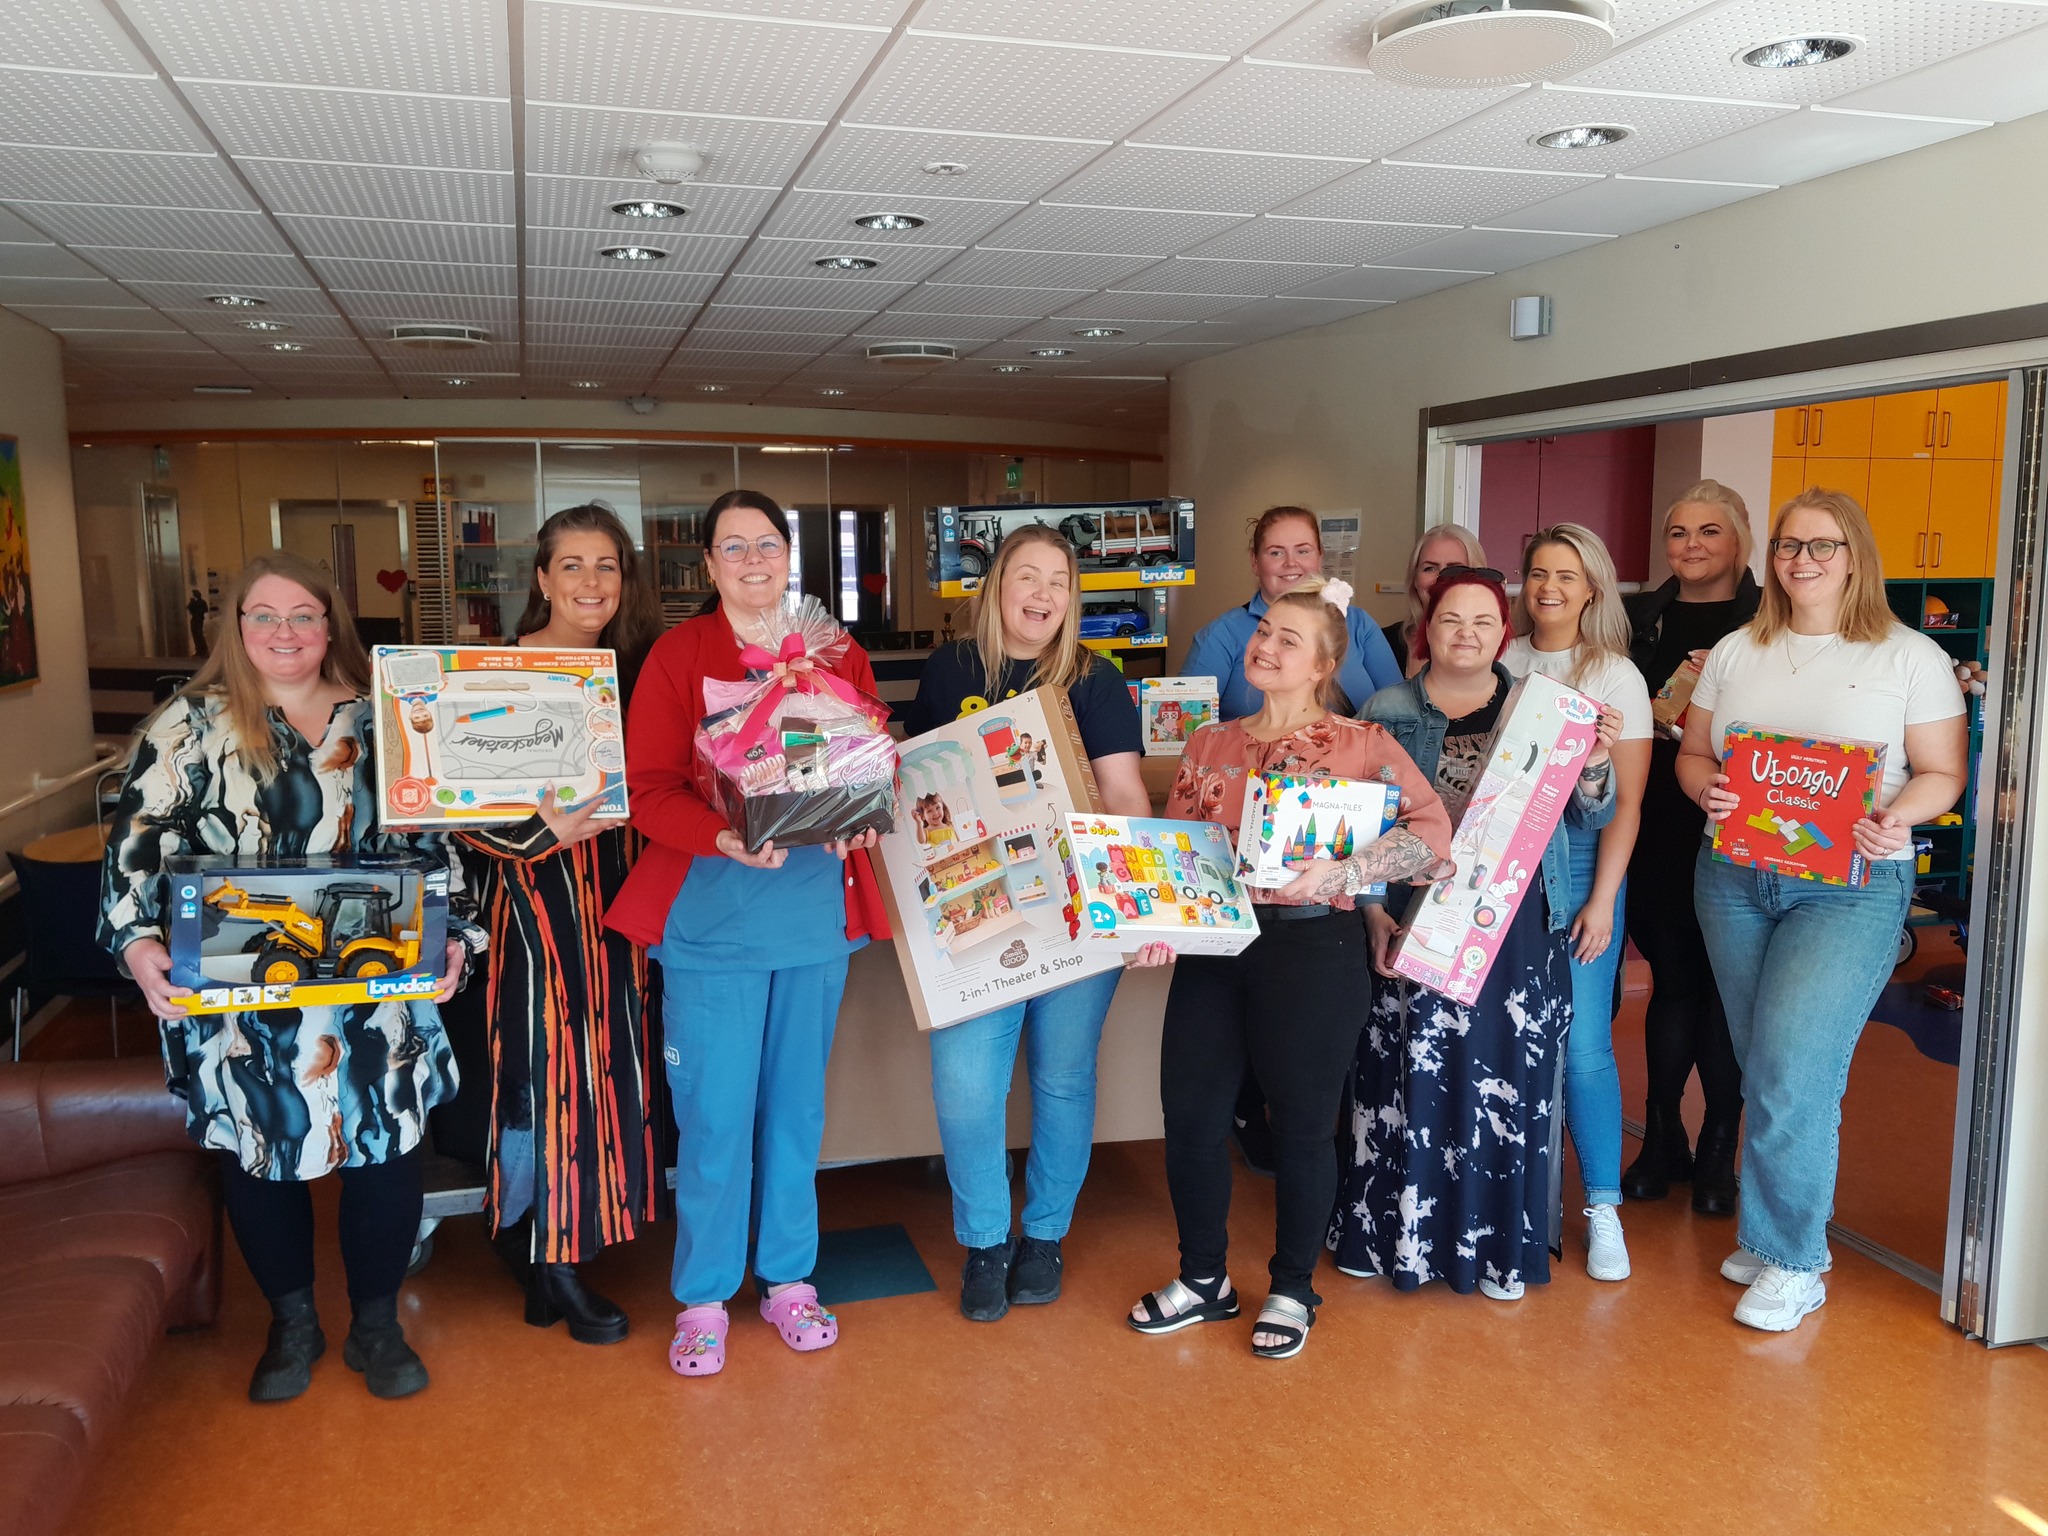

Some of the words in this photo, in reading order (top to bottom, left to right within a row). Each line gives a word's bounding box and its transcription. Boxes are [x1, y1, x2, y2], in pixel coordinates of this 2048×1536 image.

[1140, 567, 1184, 582] bruder
[1130, 634, 1163, 645] bruder
[547, 674, 571, 683] TOMY
[1558, 697, 1594, 719] BABY
[1566, 709, 1581, 720] born
[452, 718, 564, 753] Megasketcher
[1751, 750, 1849, 799] Ubongo!
[1766, 788, 1821, 811] Classic
[1089, 826, 1119, 837] duplo
[1850, 853, 1861, 886] KOSMOS
[182, 904, 194, 913] 4+
[1092, 910, 1111, 923] 2+
[297, 921, 314, 931] JCB
[959, 982, 991, 1003] 2-in-1
[992, 966, 1037, 991] Theater
[1039, 963, 1050, 975] &
[1052, 953, 1084, 974] Shop
[368, 979, 434, 996] bruder
